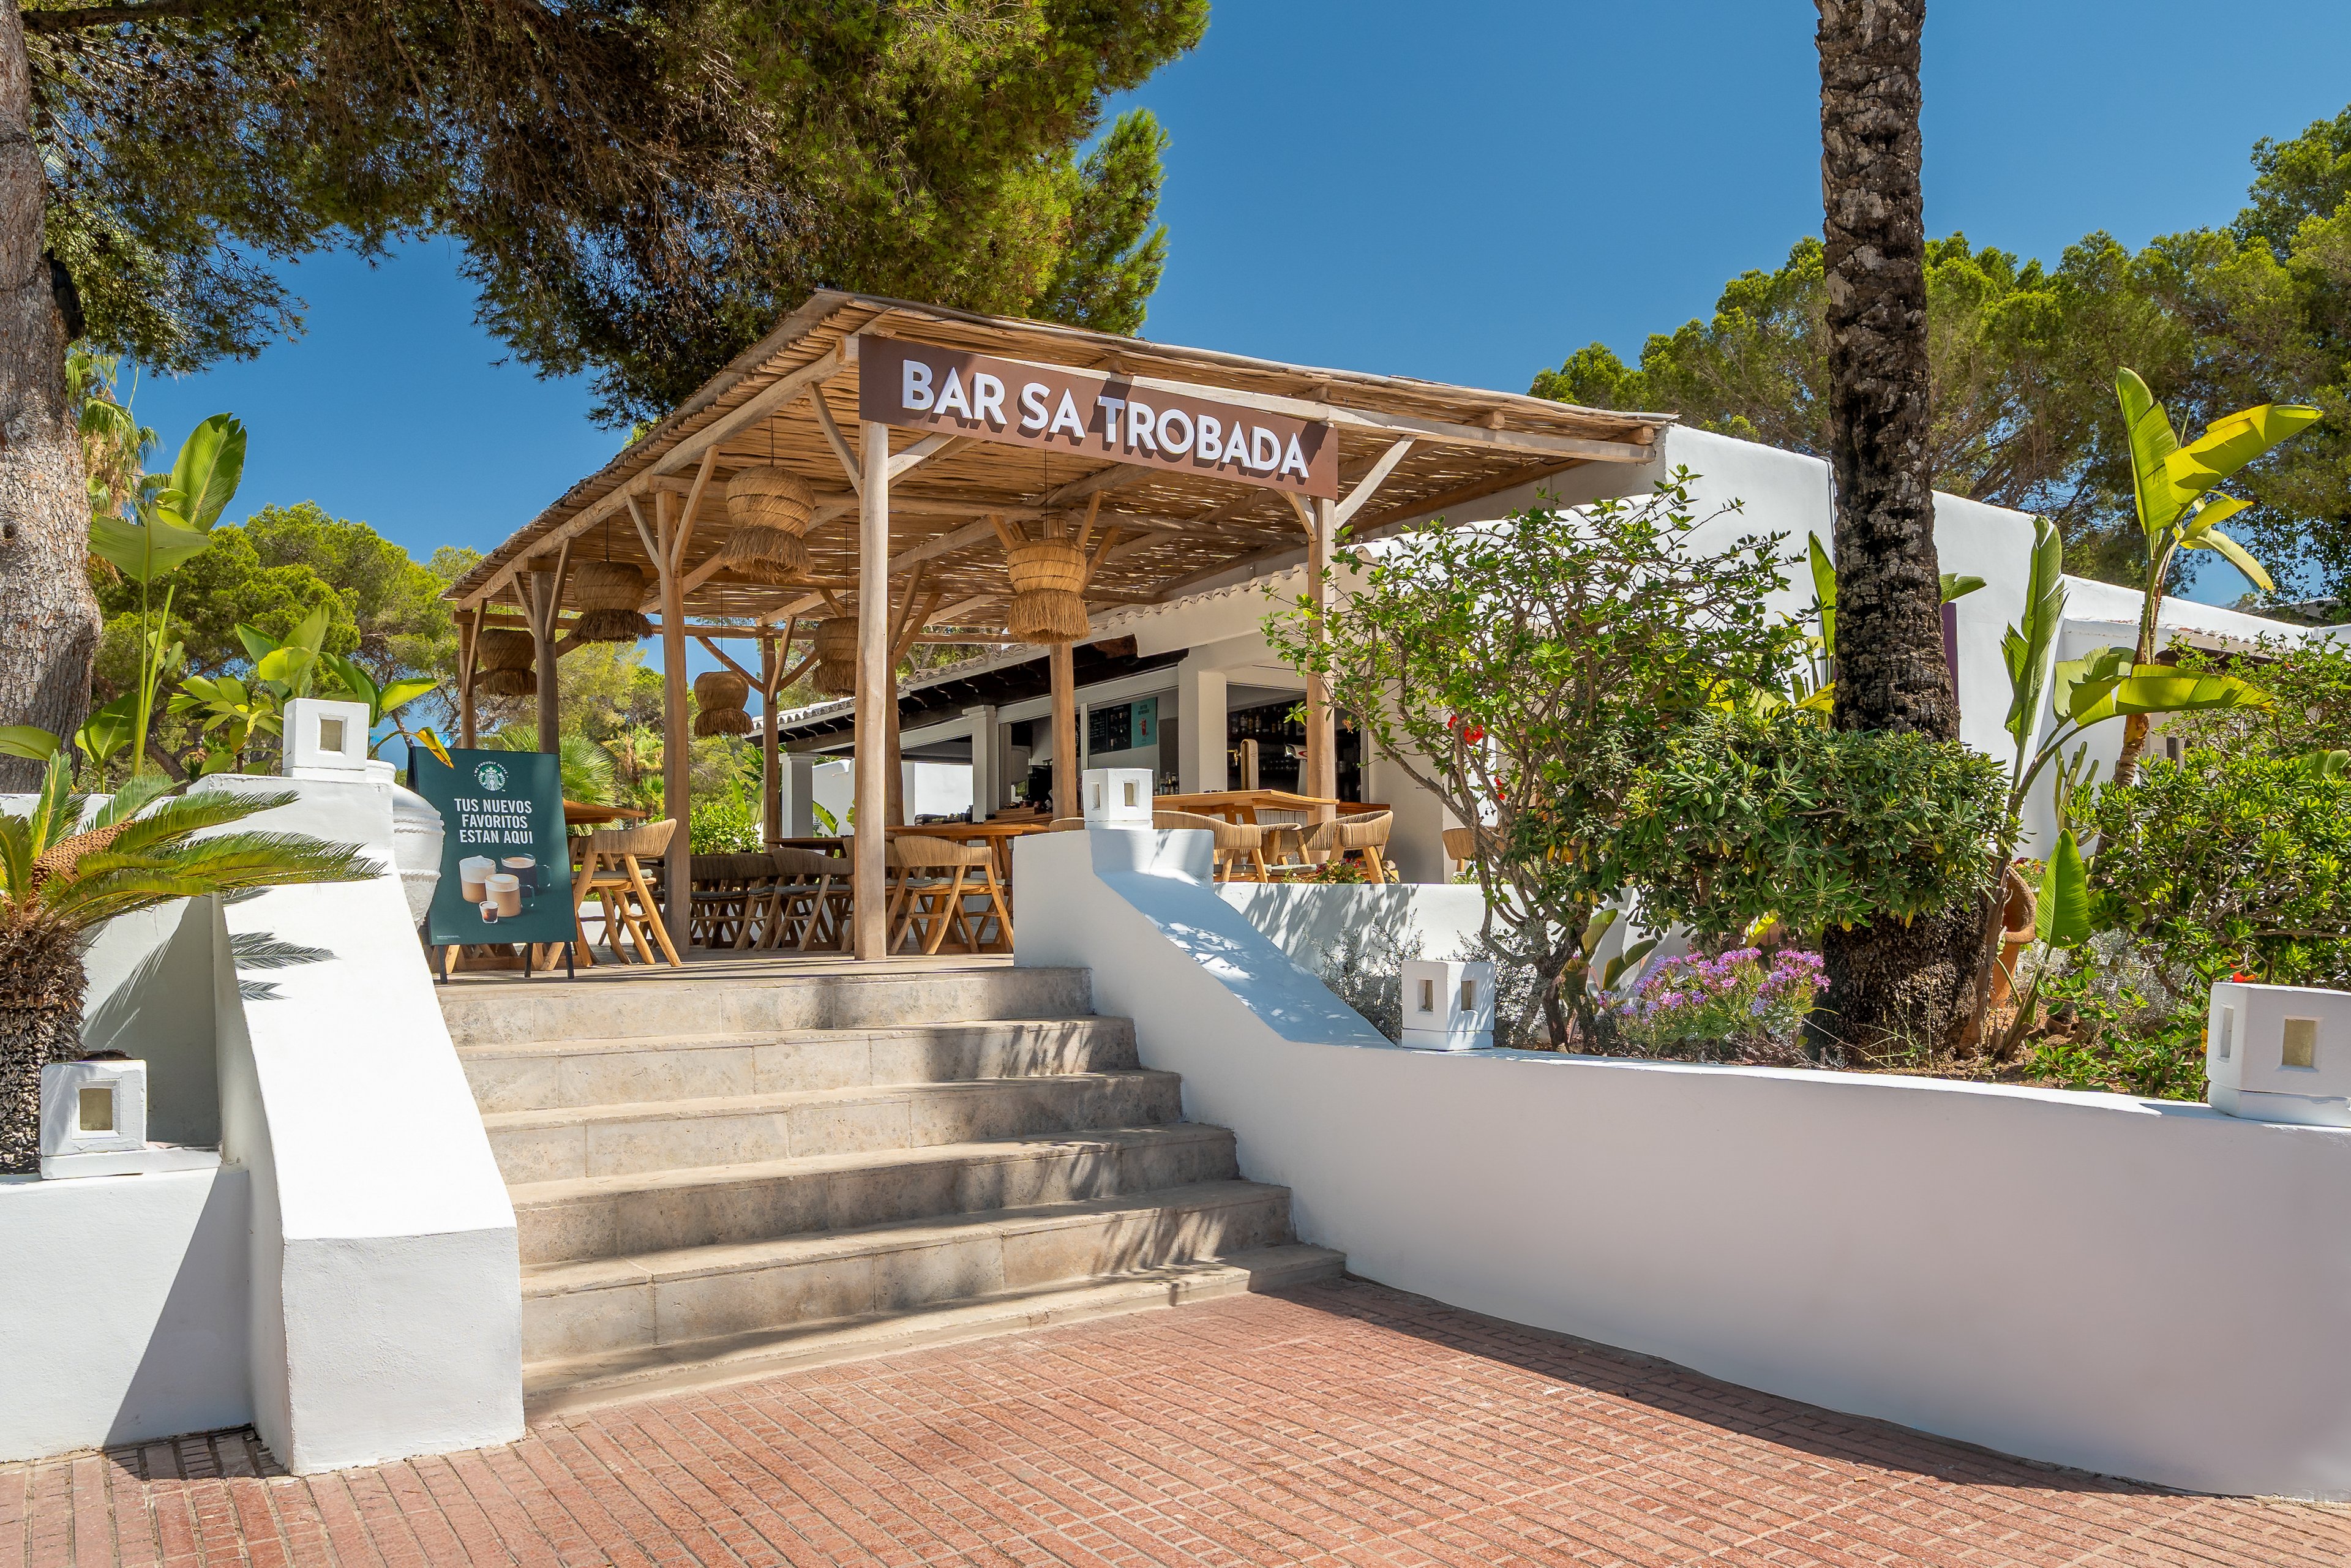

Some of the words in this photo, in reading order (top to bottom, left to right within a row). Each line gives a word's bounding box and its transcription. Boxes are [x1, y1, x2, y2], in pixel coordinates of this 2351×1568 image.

[902, 359, 1007, 426] BAR
[1021, 382, 1086, 439] SA
[1097, 395, 1310, 479] TROBADA
[497, 763, 508, 775] SERVE
[454, 798, 479, 812] TUS
[482, 799, 532, 814] NUEVOS
[462, 814, 528, 829] FAVORITOS
[459, 829, 499, 843] ESTAN
[503, 830, 533, 844] AQUI
